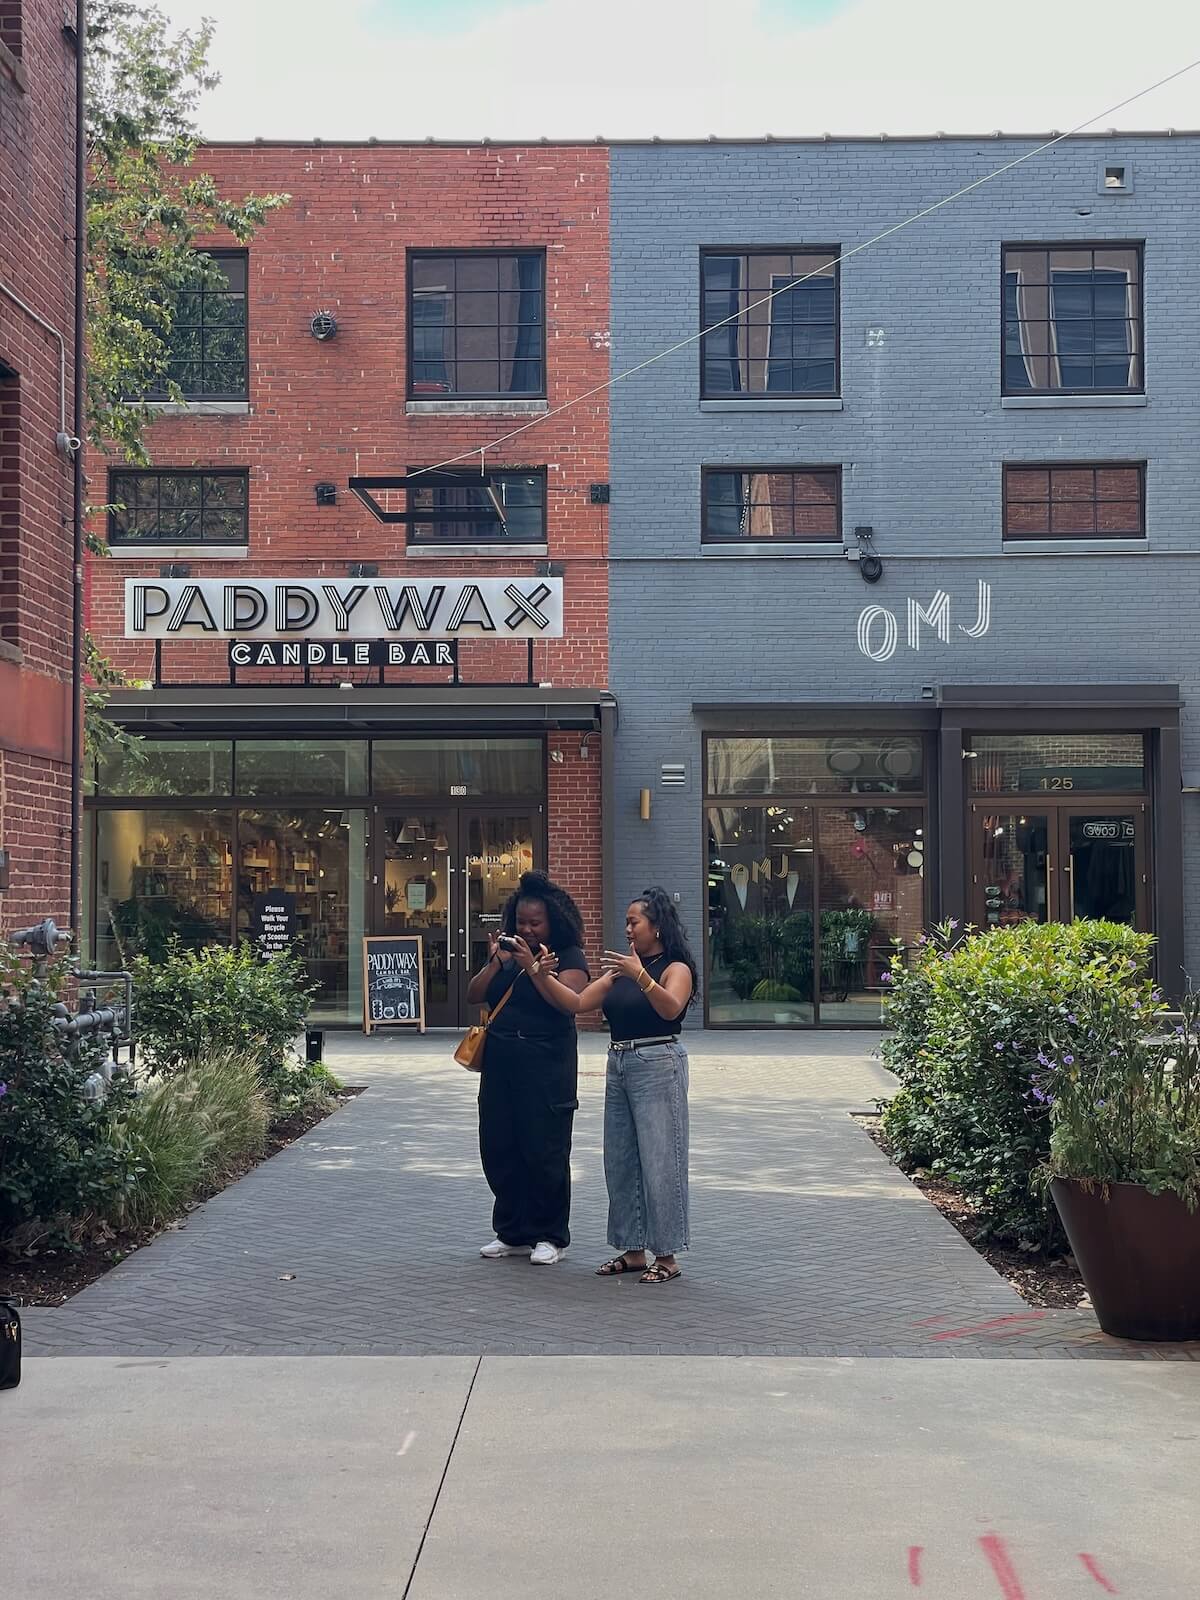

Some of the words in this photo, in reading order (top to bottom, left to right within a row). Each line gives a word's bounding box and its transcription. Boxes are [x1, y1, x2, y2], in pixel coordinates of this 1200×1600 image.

[133, 583, 552, 632] PADDYWAX
[857, 579, 991, 662] OMJ
[231, 643, 370, 665] CANDLE
[388, 643, 455, 665] BAR
[1040, 777, 1074, 790] 125
[731, 853, 789, 885] OMJ
[368, 953, 418, 970] PADDYWAX
